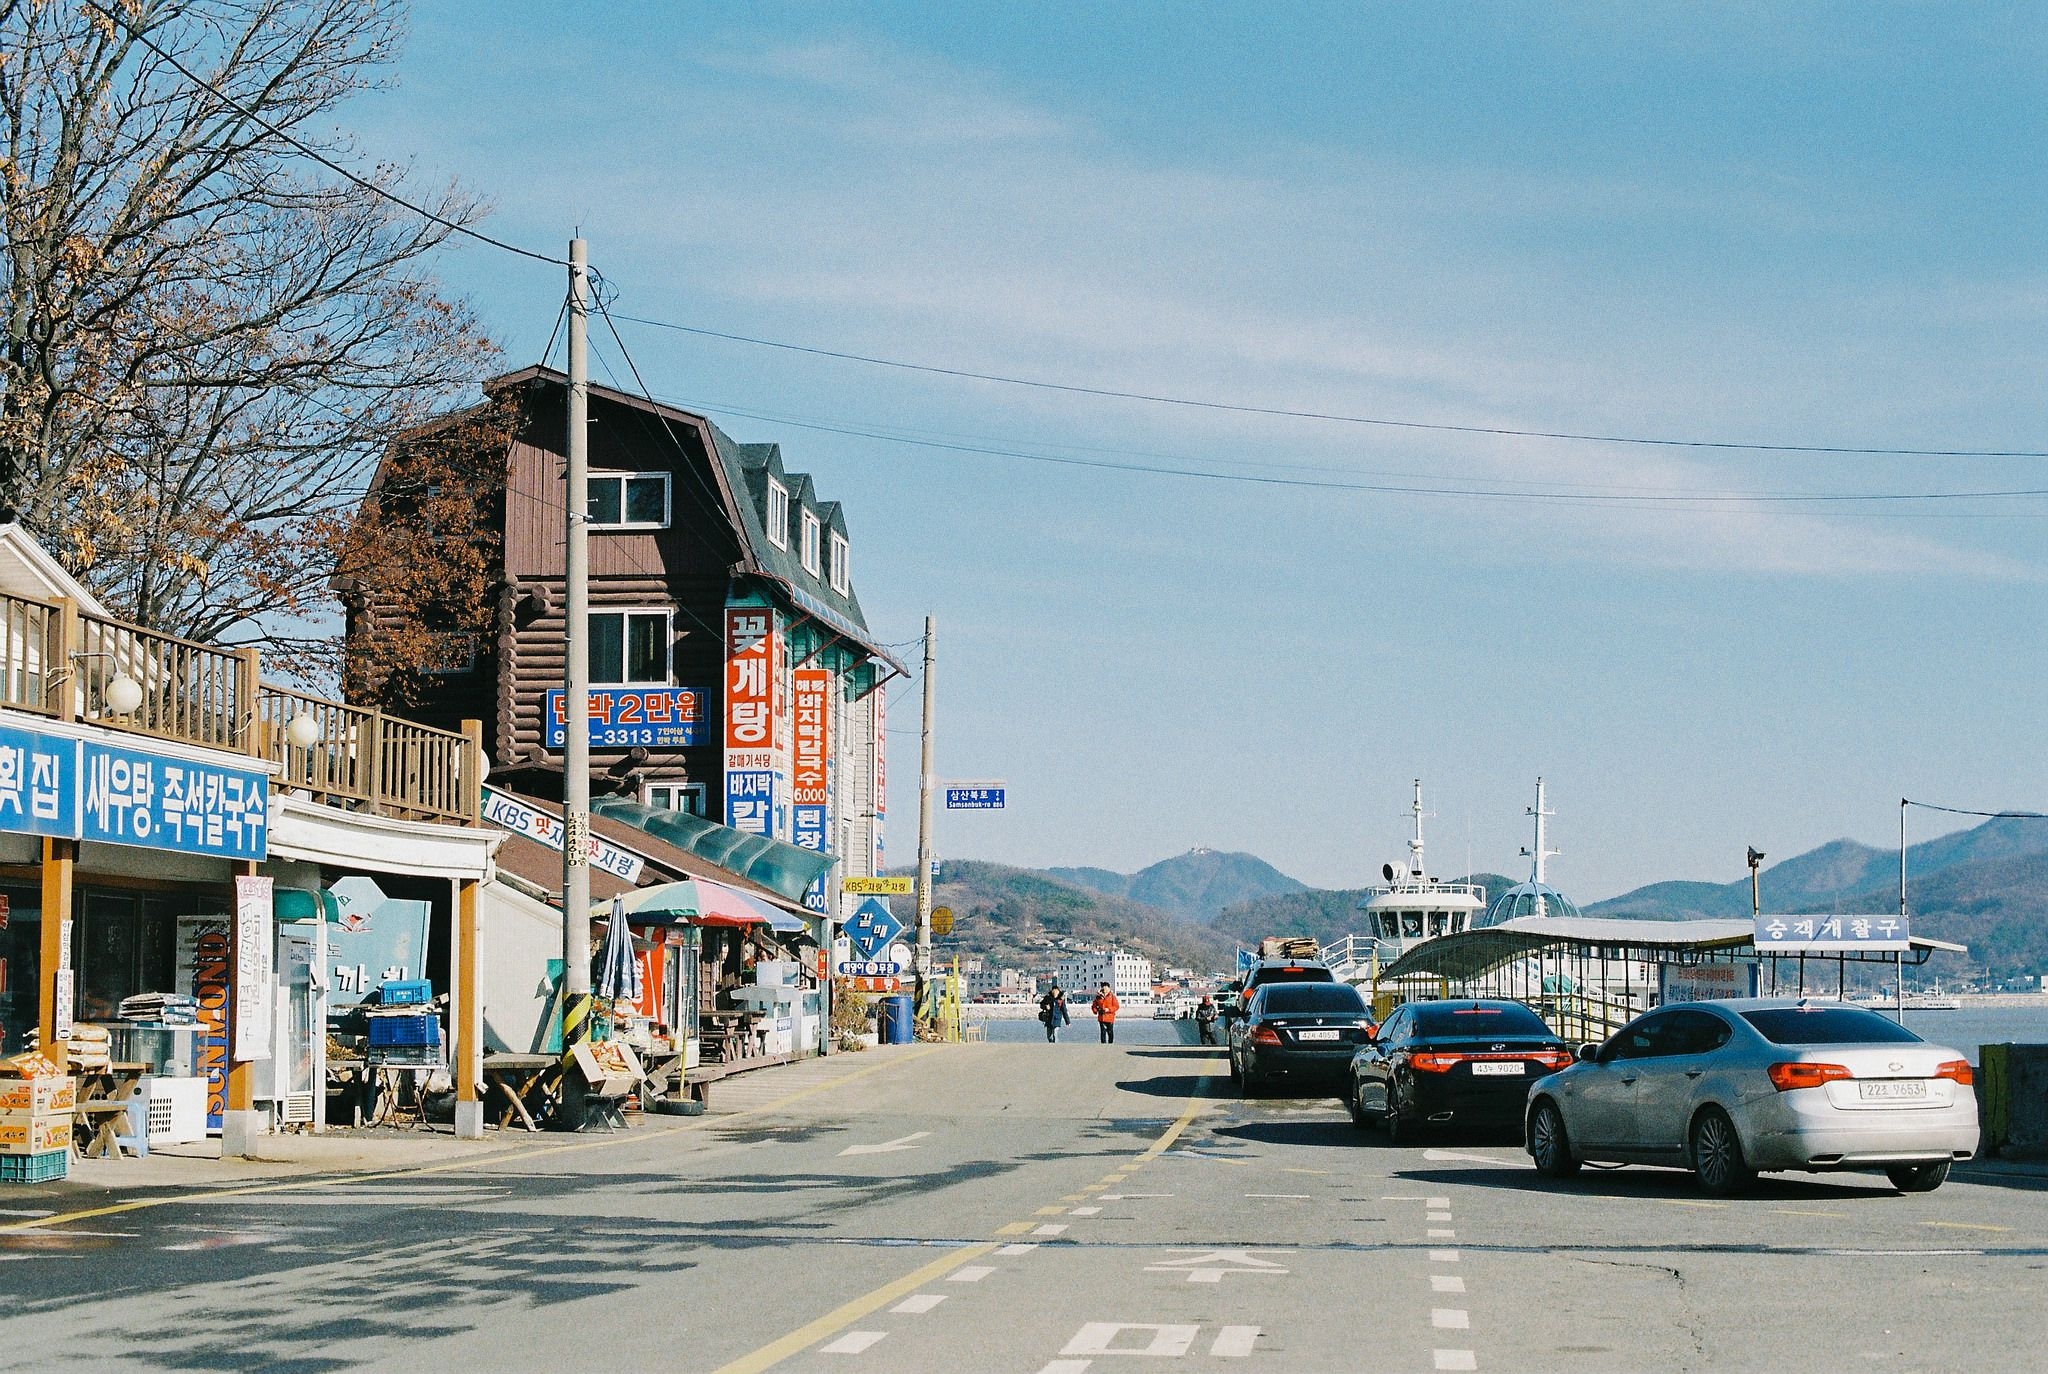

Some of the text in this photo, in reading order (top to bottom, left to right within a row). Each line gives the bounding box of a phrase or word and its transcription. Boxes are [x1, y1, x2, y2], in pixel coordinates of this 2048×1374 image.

[732, 616, 770, 742] 꽃게탕
[553, 729, 652, 745] 9-3313
[797, 694, 823, 786] 바지락칼국수
[728, 754, 771, 768] 갈매기식당
[730, 774, 772, 797] 바지락
[794, 788, 826, 802] 6,000
[950, 790, 989, 801] 삼산북로
[491, 800, 533, 831] KBS
[845, 882, 862, 892] KBS
[1765, 919, 1900, 940] 승객개찰구
[1497, 1064, 1520, 1074] 9020
